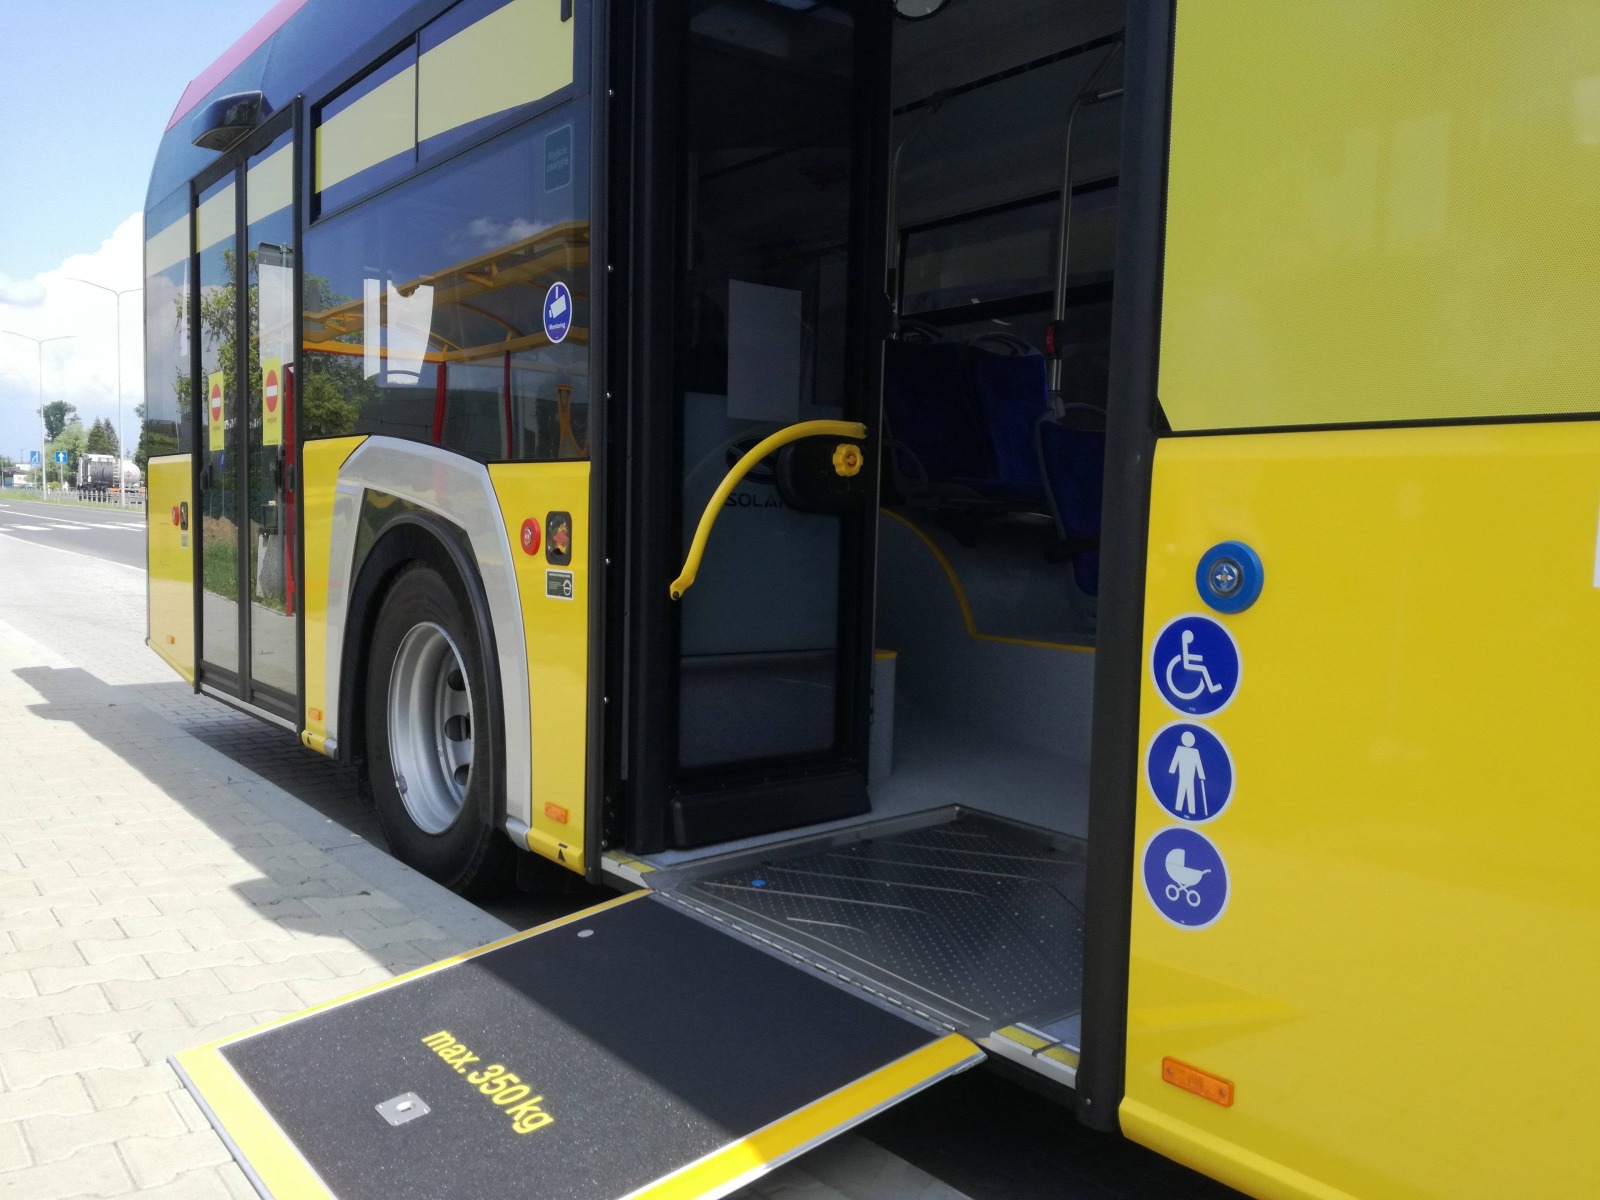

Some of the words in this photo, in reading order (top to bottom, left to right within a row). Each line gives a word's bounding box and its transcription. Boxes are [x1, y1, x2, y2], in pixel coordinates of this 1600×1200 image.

[549, 322, 566, 330] Monitoring
[725, 492, 783, 508] SOLA
[421, 1030, 480, 1074] max.
[467, 1064, 530, 1105] 350
[505, 1096, 554, 1134] kg
